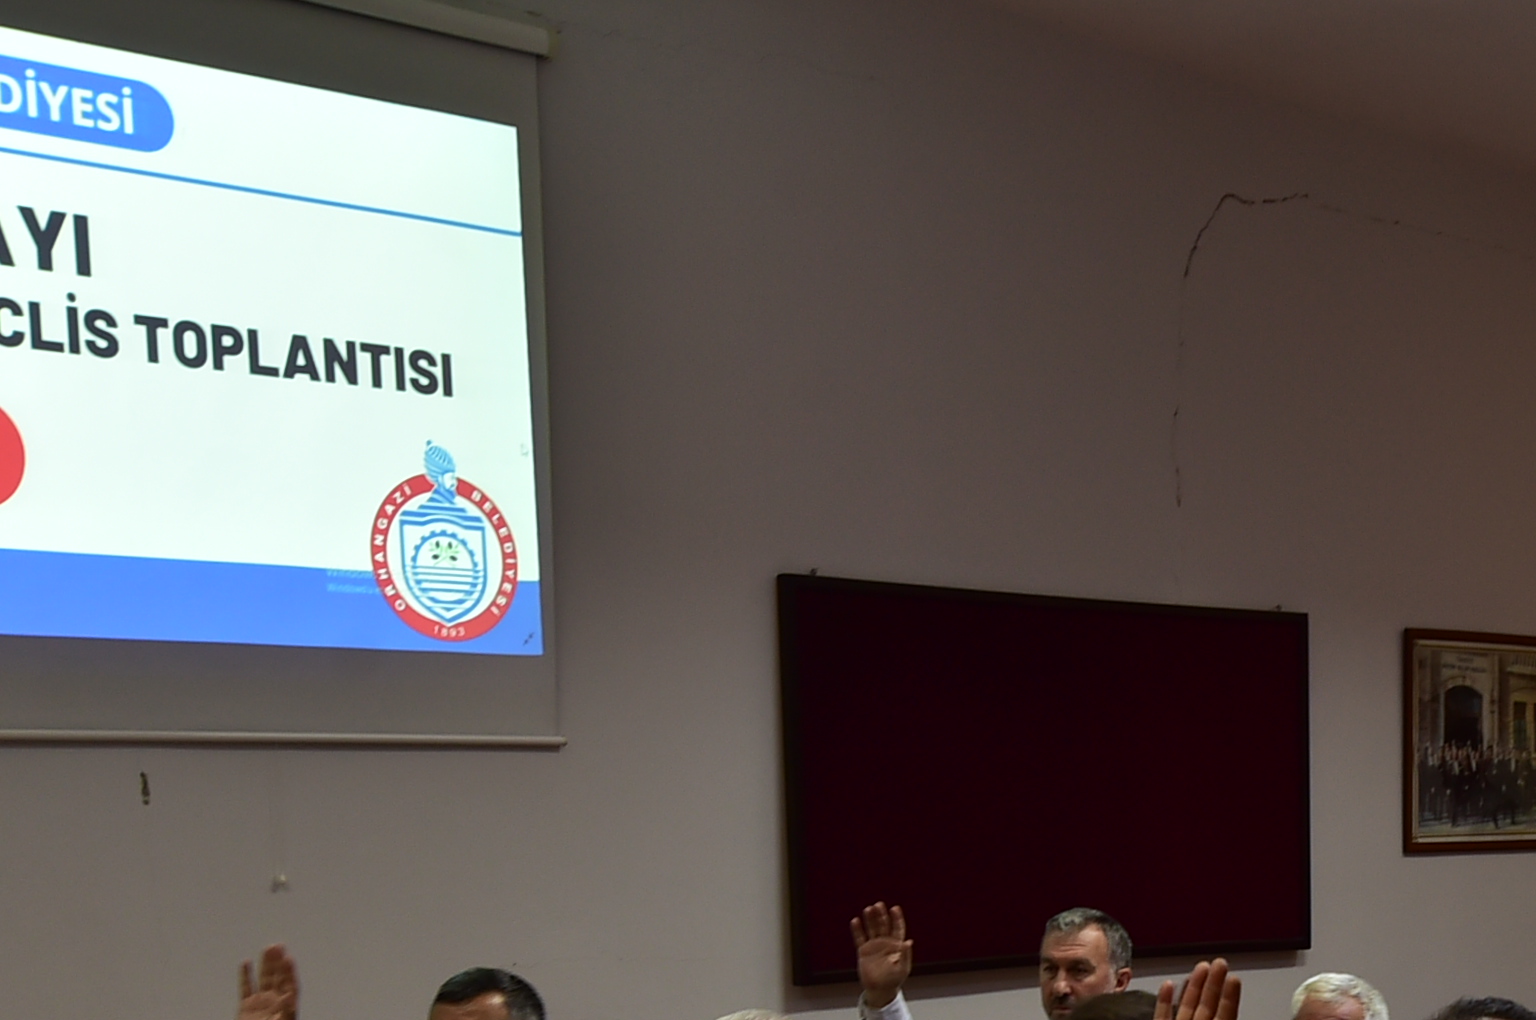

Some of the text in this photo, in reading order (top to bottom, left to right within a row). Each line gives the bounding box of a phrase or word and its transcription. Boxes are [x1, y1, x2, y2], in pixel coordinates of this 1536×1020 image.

[133, 314, 454, 398] TOPLANTISI
[373, 483, 412, 612] ORHANGAZİ
[471, 490, 518, 617] BELEDİYESİ
[433, 624, 466, 638] 1893
